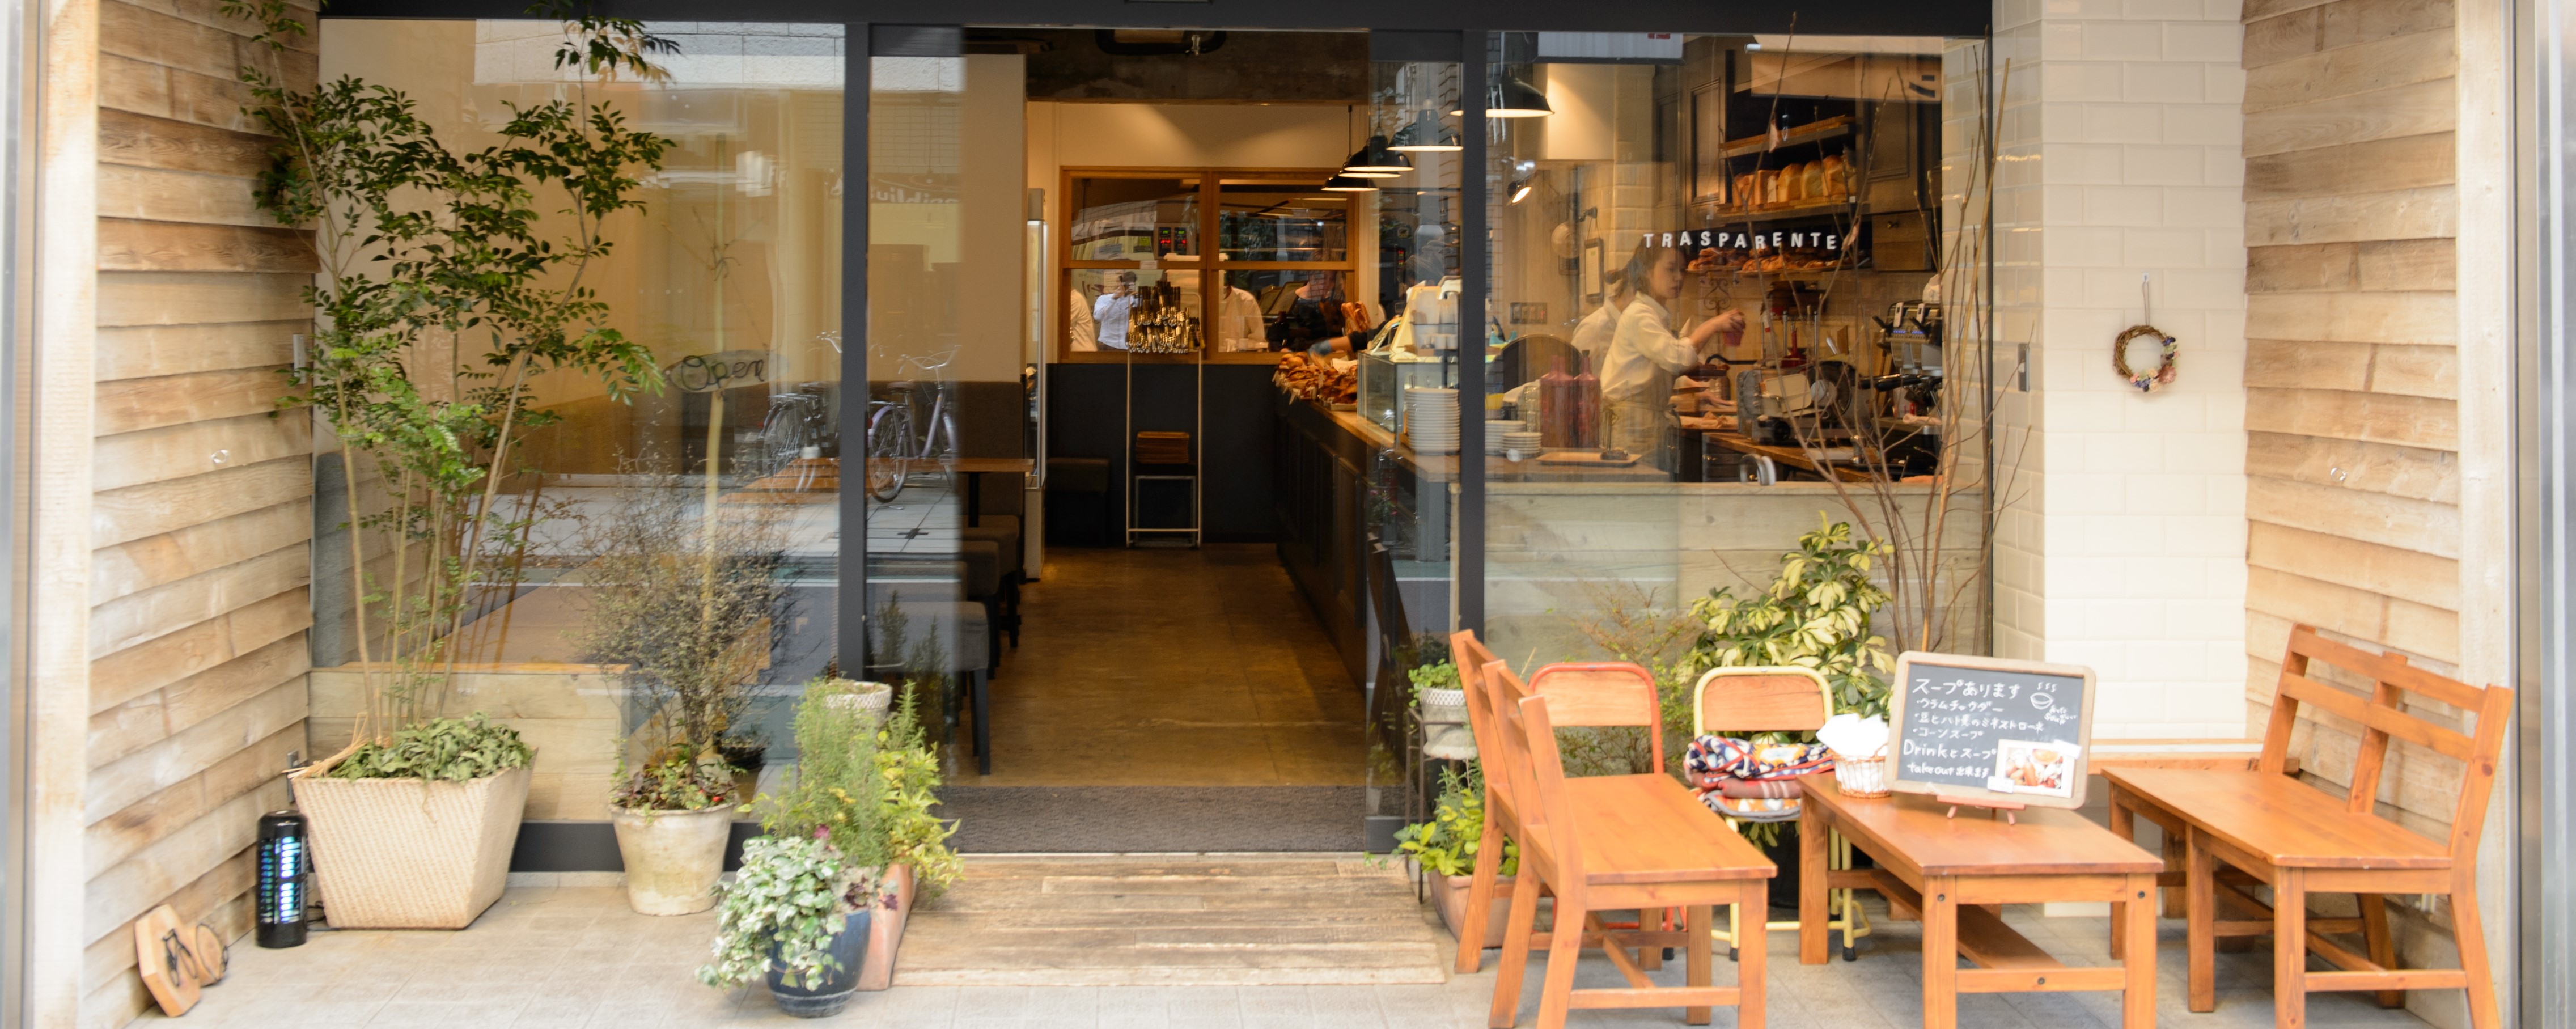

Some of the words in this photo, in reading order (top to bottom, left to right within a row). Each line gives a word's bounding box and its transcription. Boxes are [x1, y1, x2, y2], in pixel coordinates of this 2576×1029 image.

[1643, 231, 1837, 250] TRASPARENTE
[681, 355, 765, 390] Open
[1912, 679, 2021, 699] スープあります
